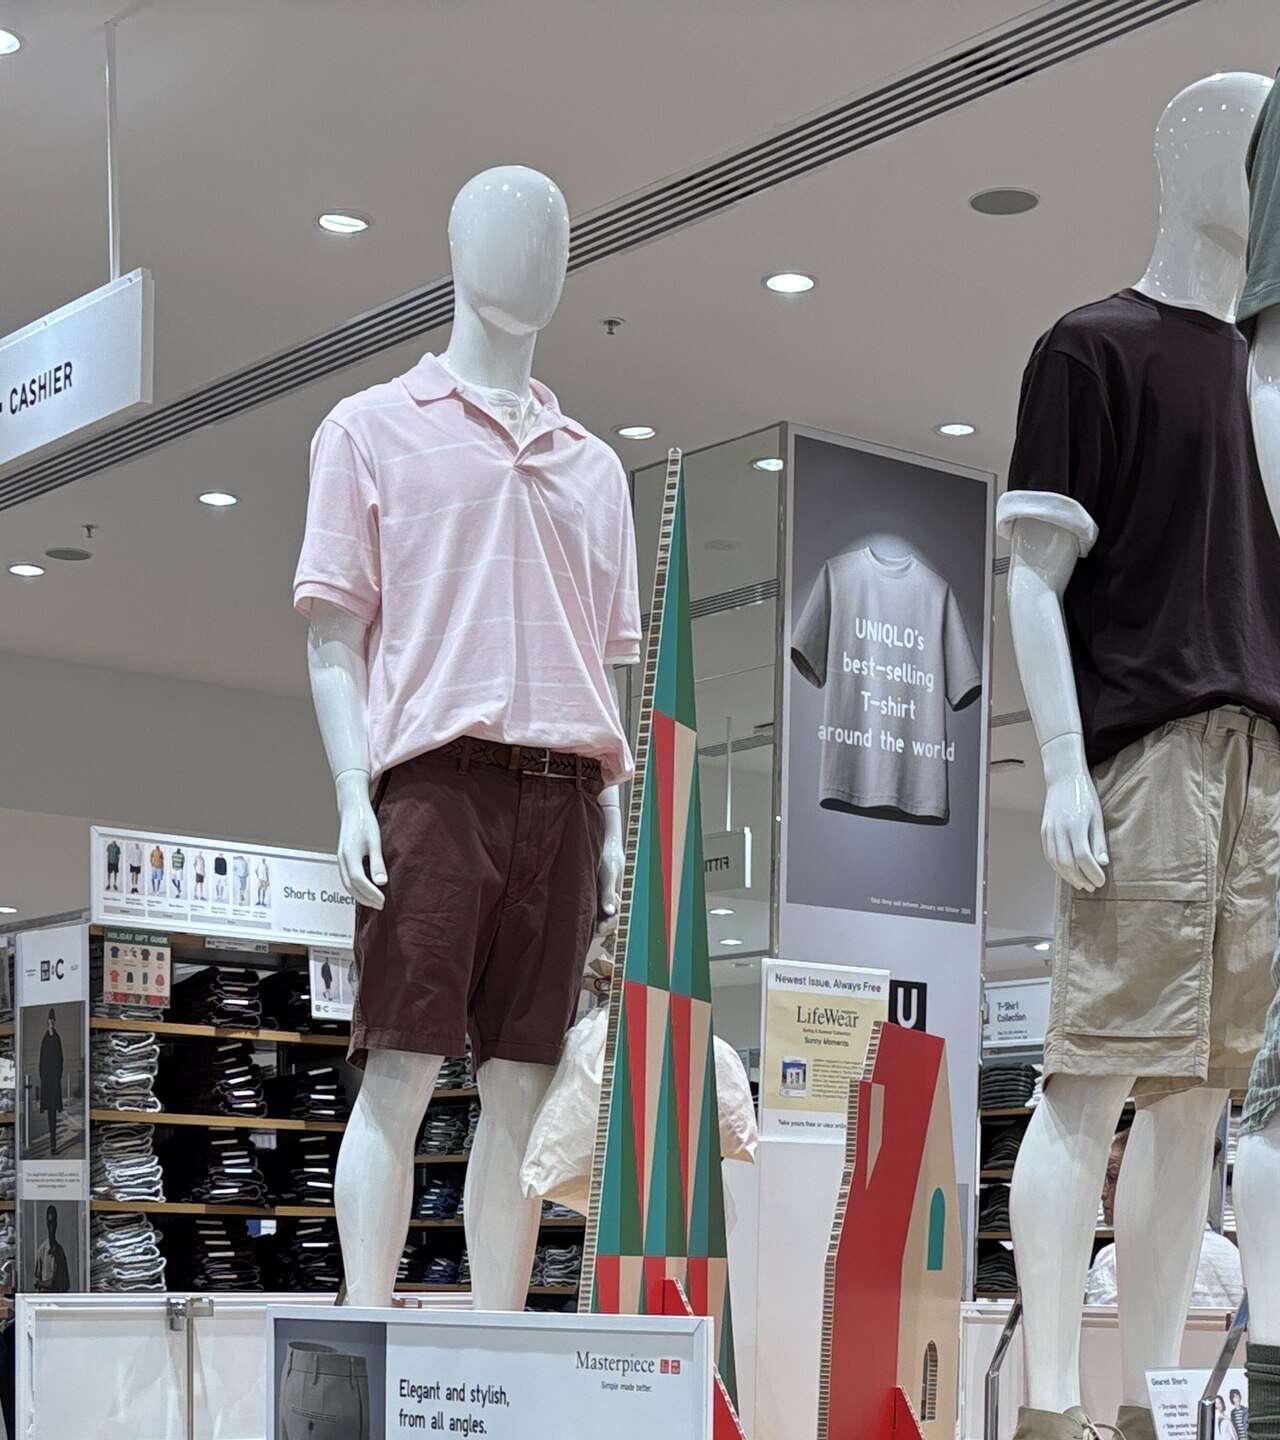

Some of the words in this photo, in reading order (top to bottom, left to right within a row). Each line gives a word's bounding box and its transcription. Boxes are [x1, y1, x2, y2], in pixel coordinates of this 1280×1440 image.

[8, 360, 74, 416] CASHIER
[853, 615, 926, 652] UNIQLO's
[842, 651, 935, 692] best-selling
[860, 690, 917, 721] T-shirt
[817, 723, 873, 748] around
[879, 728, 905, 753] the
[912, 732, 955, 762] world
[283, 886, 316, 901] Shorts
[775, 972, 807, 987] Newest
[809, 976, 832, 991] Issue,
[833, 979, 862, 994] Always
[863, 981, 882, 994] Free
[796, 1005, 860, 1029] LifeWear
[896, 987, 918, 1029] U
[575, 1351, 655, 1379] Masterpiece
[399, 1378, 441, 1404] Elegant
[446, 1383, 466, 1402] and
[470, 1384, 510, 1408] stylish,
[601, 1381, 619, 1392] Simple
[620, 1382, 635, 1391] made
[399, 1408, 426, 1429] from
[431, 1410, 445, 1430] all
[449, 1414, 488, 1438] angles.
